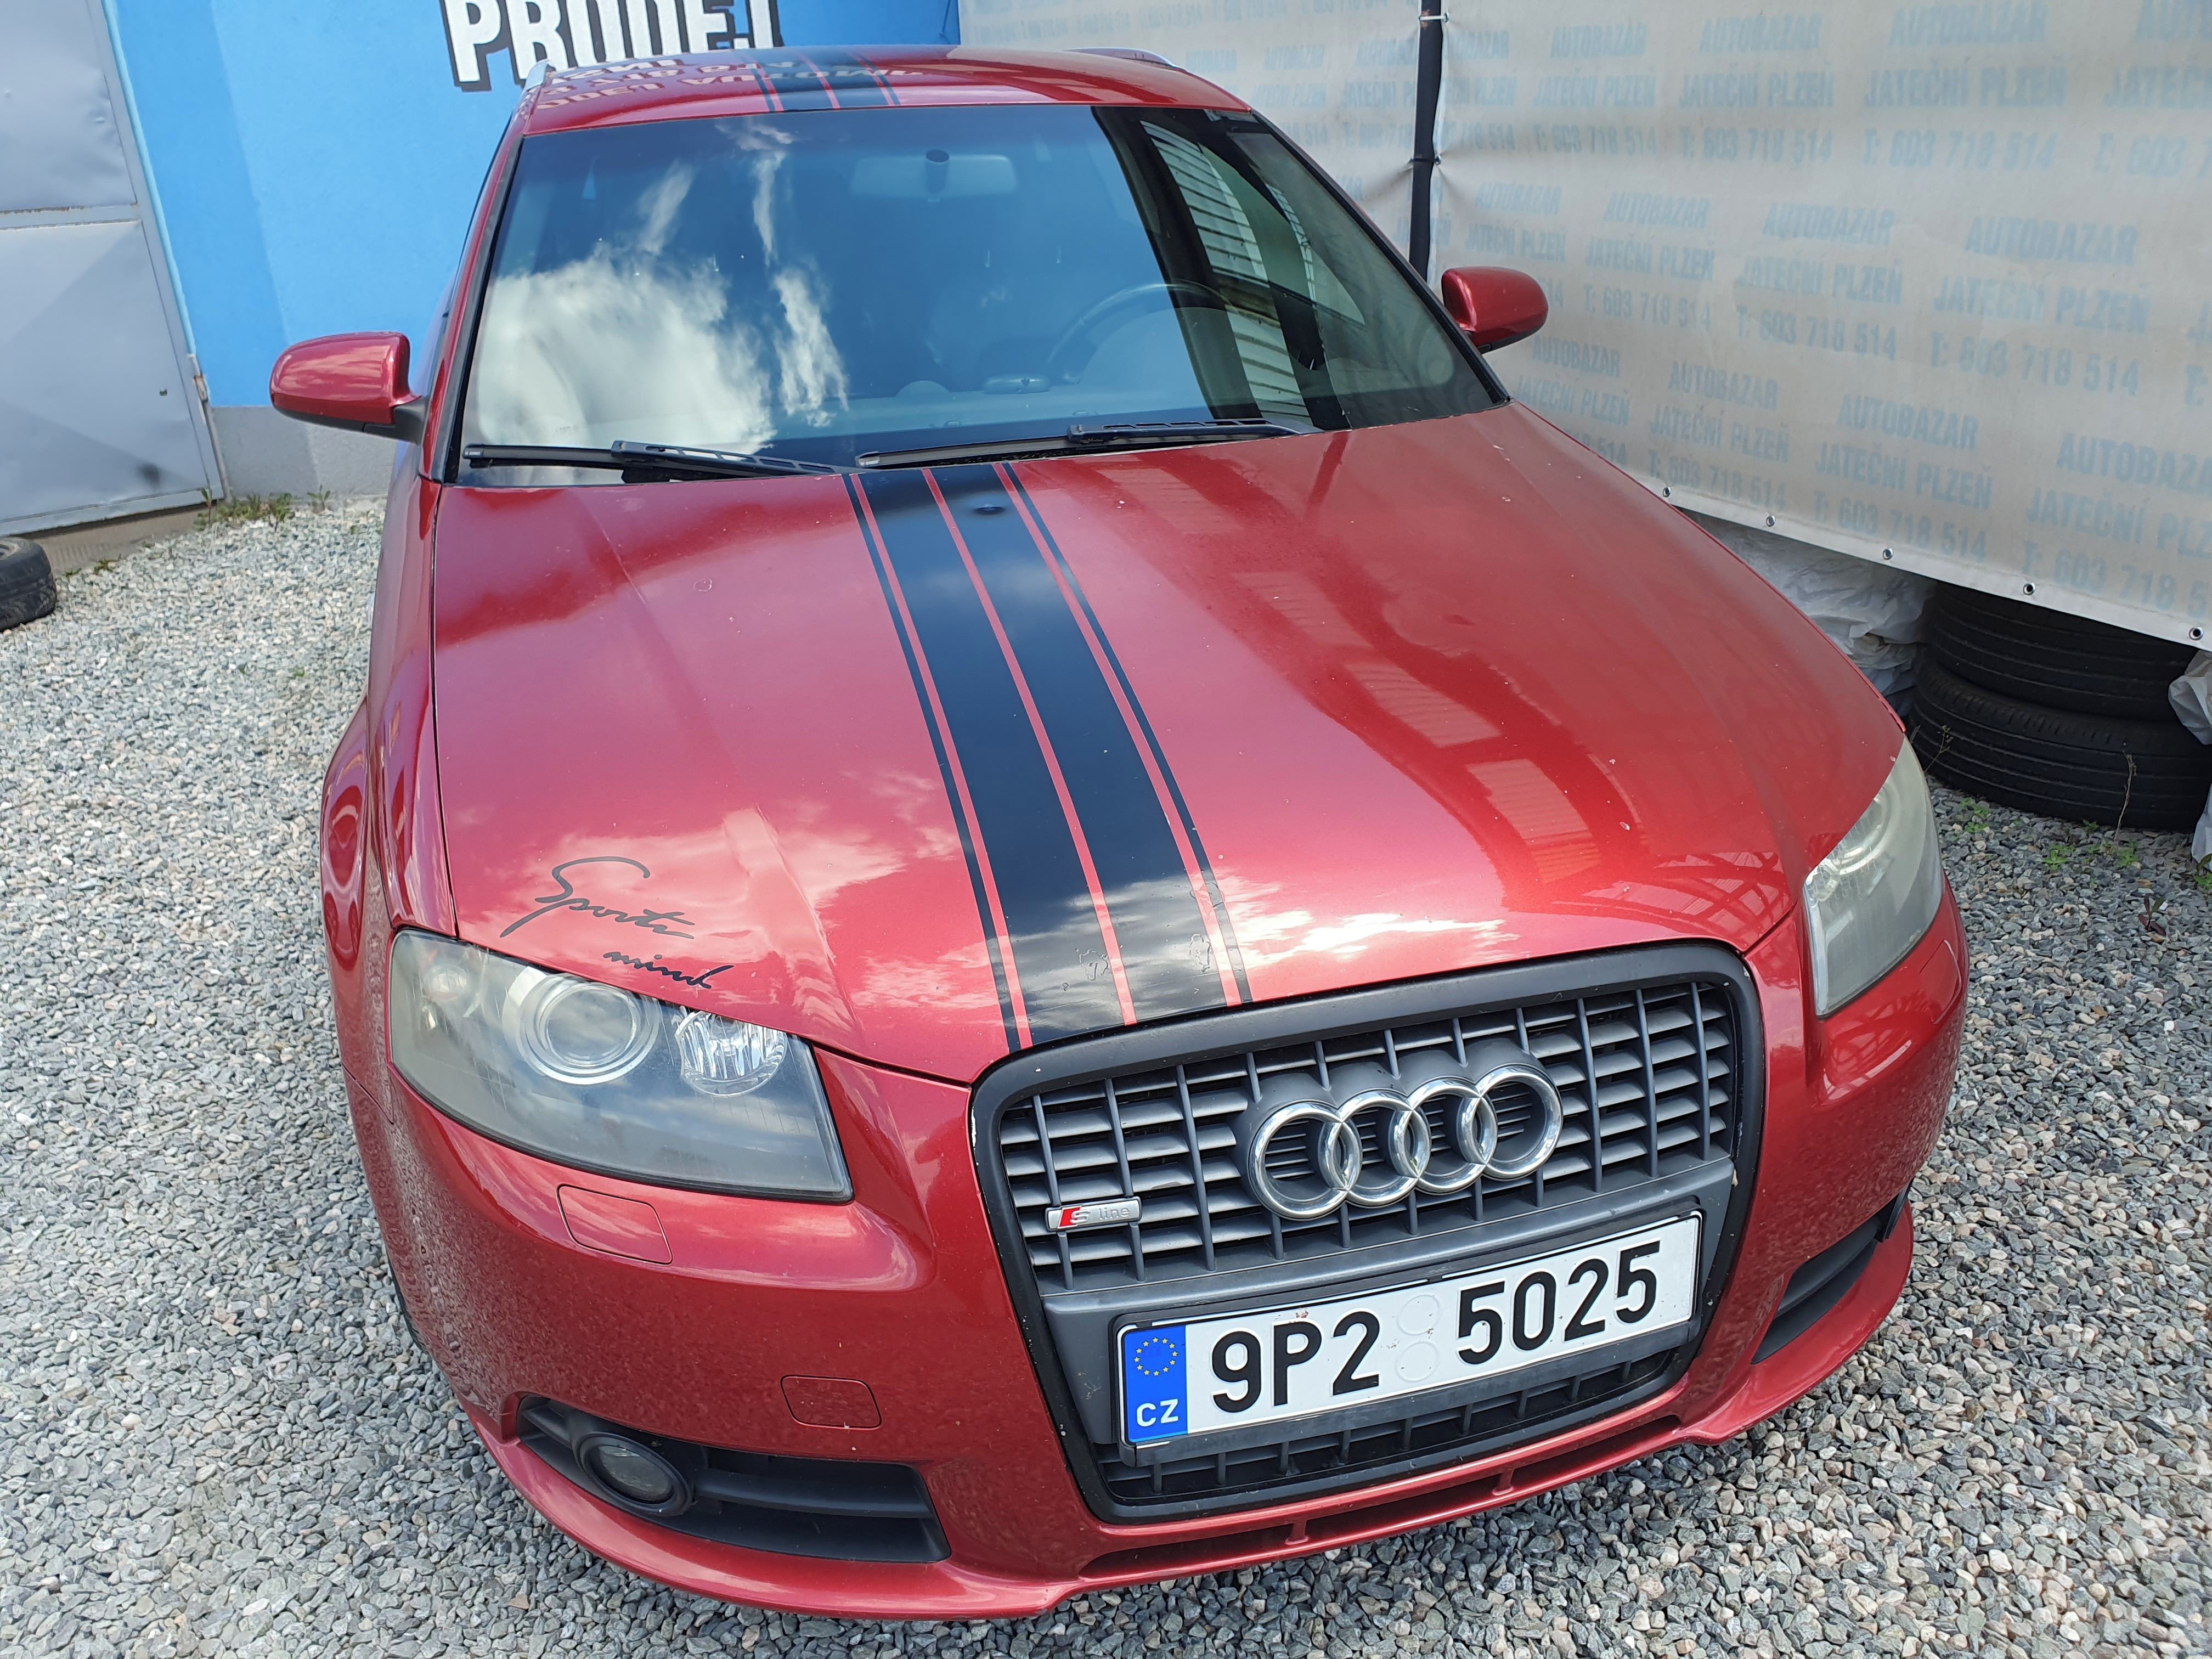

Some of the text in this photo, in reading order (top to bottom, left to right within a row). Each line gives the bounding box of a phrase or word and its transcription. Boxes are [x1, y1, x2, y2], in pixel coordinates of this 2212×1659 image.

[1838, 394, 1978, 450] AUTOBAZAR
[1098, 1207, 1130, 1221] line
[1211, 1241, 1661, 1413] 9P2 5025
[1136, 1398, 1179, 1427] CZ
